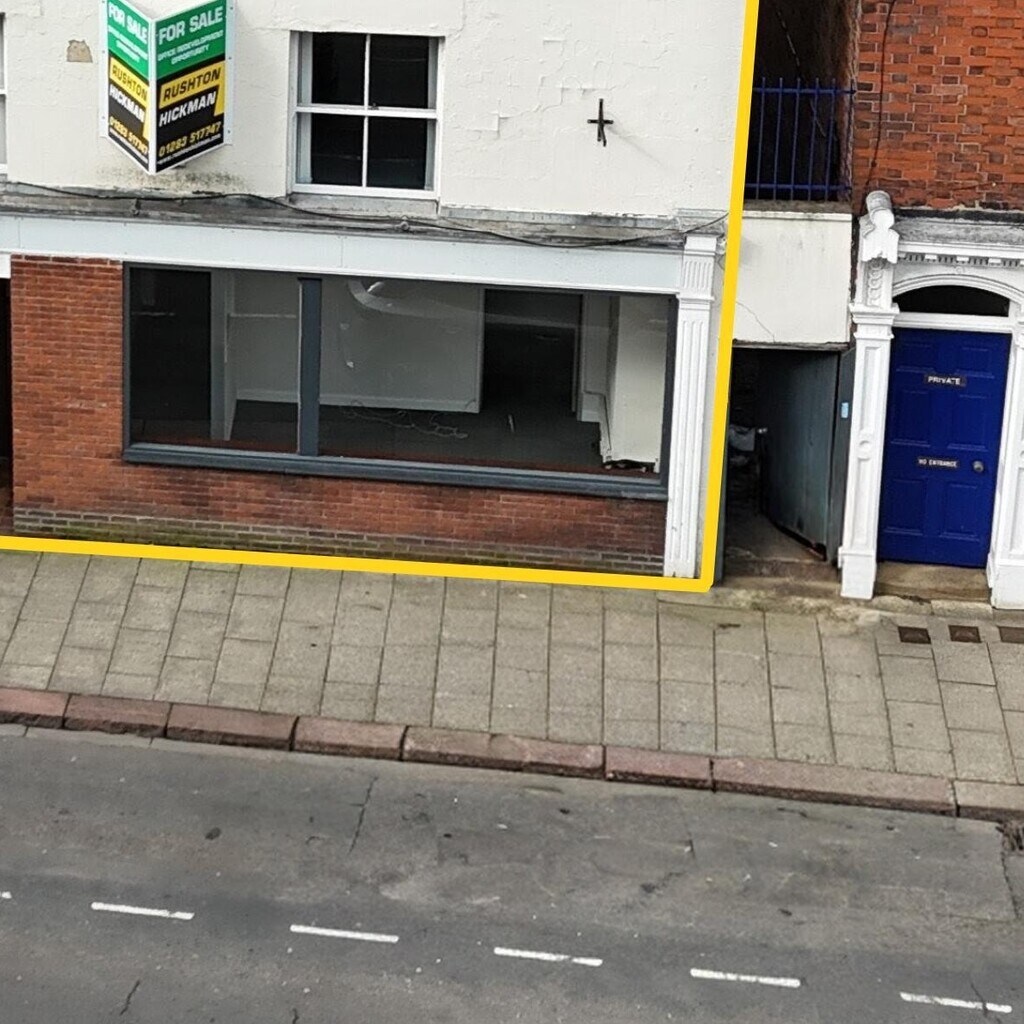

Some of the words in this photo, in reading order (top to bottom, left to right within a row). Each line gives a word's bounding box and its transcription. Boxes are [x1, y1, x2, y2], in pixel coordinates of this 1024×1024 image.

[109, 2, 125, 27] FOR
[127, 15, 147, 45] SALE
[159, 21, 185, 45] FOR
[189, 6, 223, 32] SALE
[112, 65, 147, 101] RUSHTON
[163, 67, 221, 101] RUSHTON
[110, 84, 145, 123] HICKMAN
[159, 91, 216, 127] HICKMAN
[159, 136, 187, 156] 01283
[928, 376, 961, 385] PRIVATE
